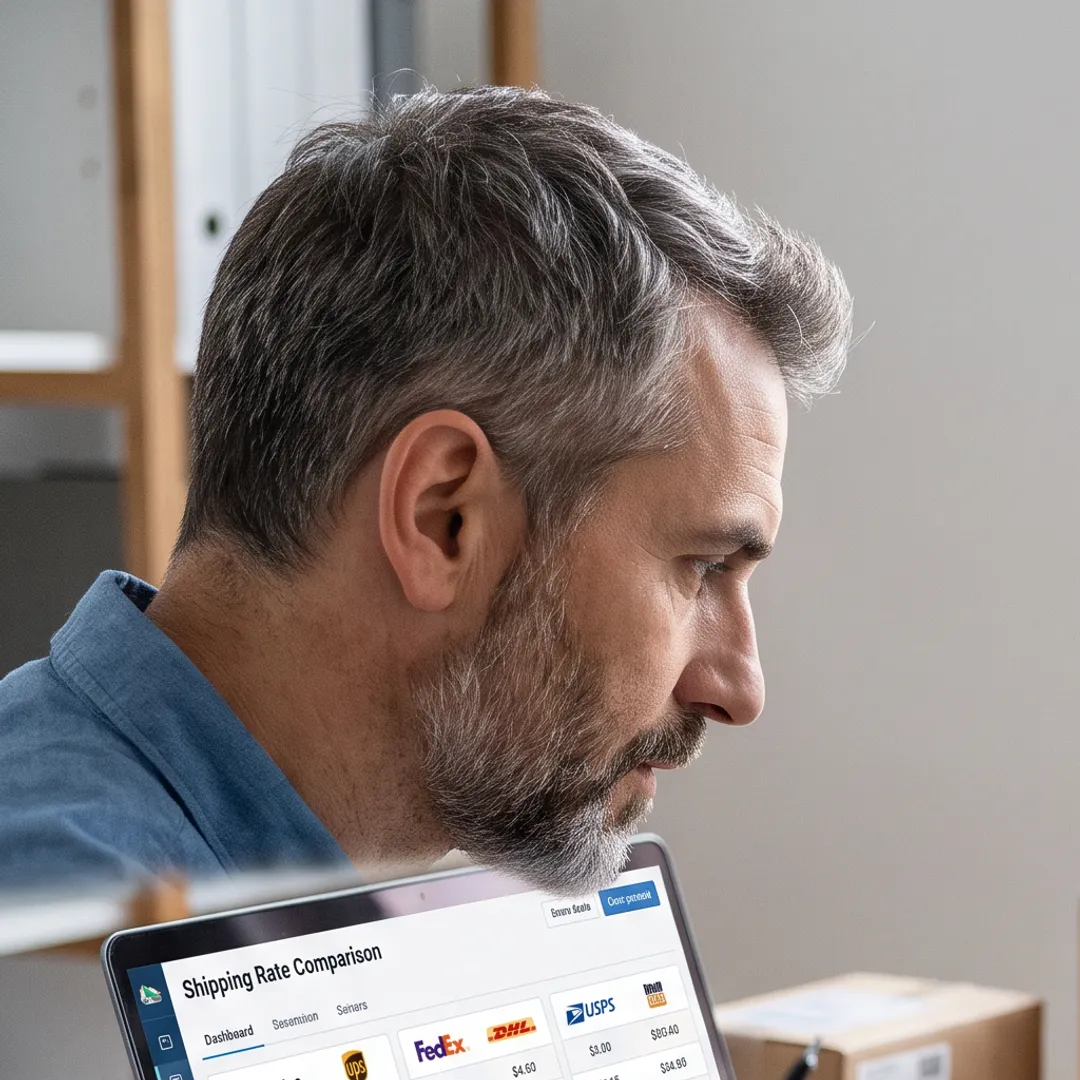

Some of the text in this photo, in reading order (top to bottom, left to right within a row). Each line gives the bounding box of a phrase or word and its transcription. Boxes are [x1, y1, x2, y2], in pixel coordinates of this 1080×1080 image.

[182, 946, 382, 1000] Shipping Rate Comparison
[583, 997, 616, 1018] USPS
[204, 1024, 254, 1046] Dashboard
[494, 1021, 530, 1039] DHL
[414, 1034, 466, 1063] FedEx
[512, 1062, 536, 1078] $4.60
